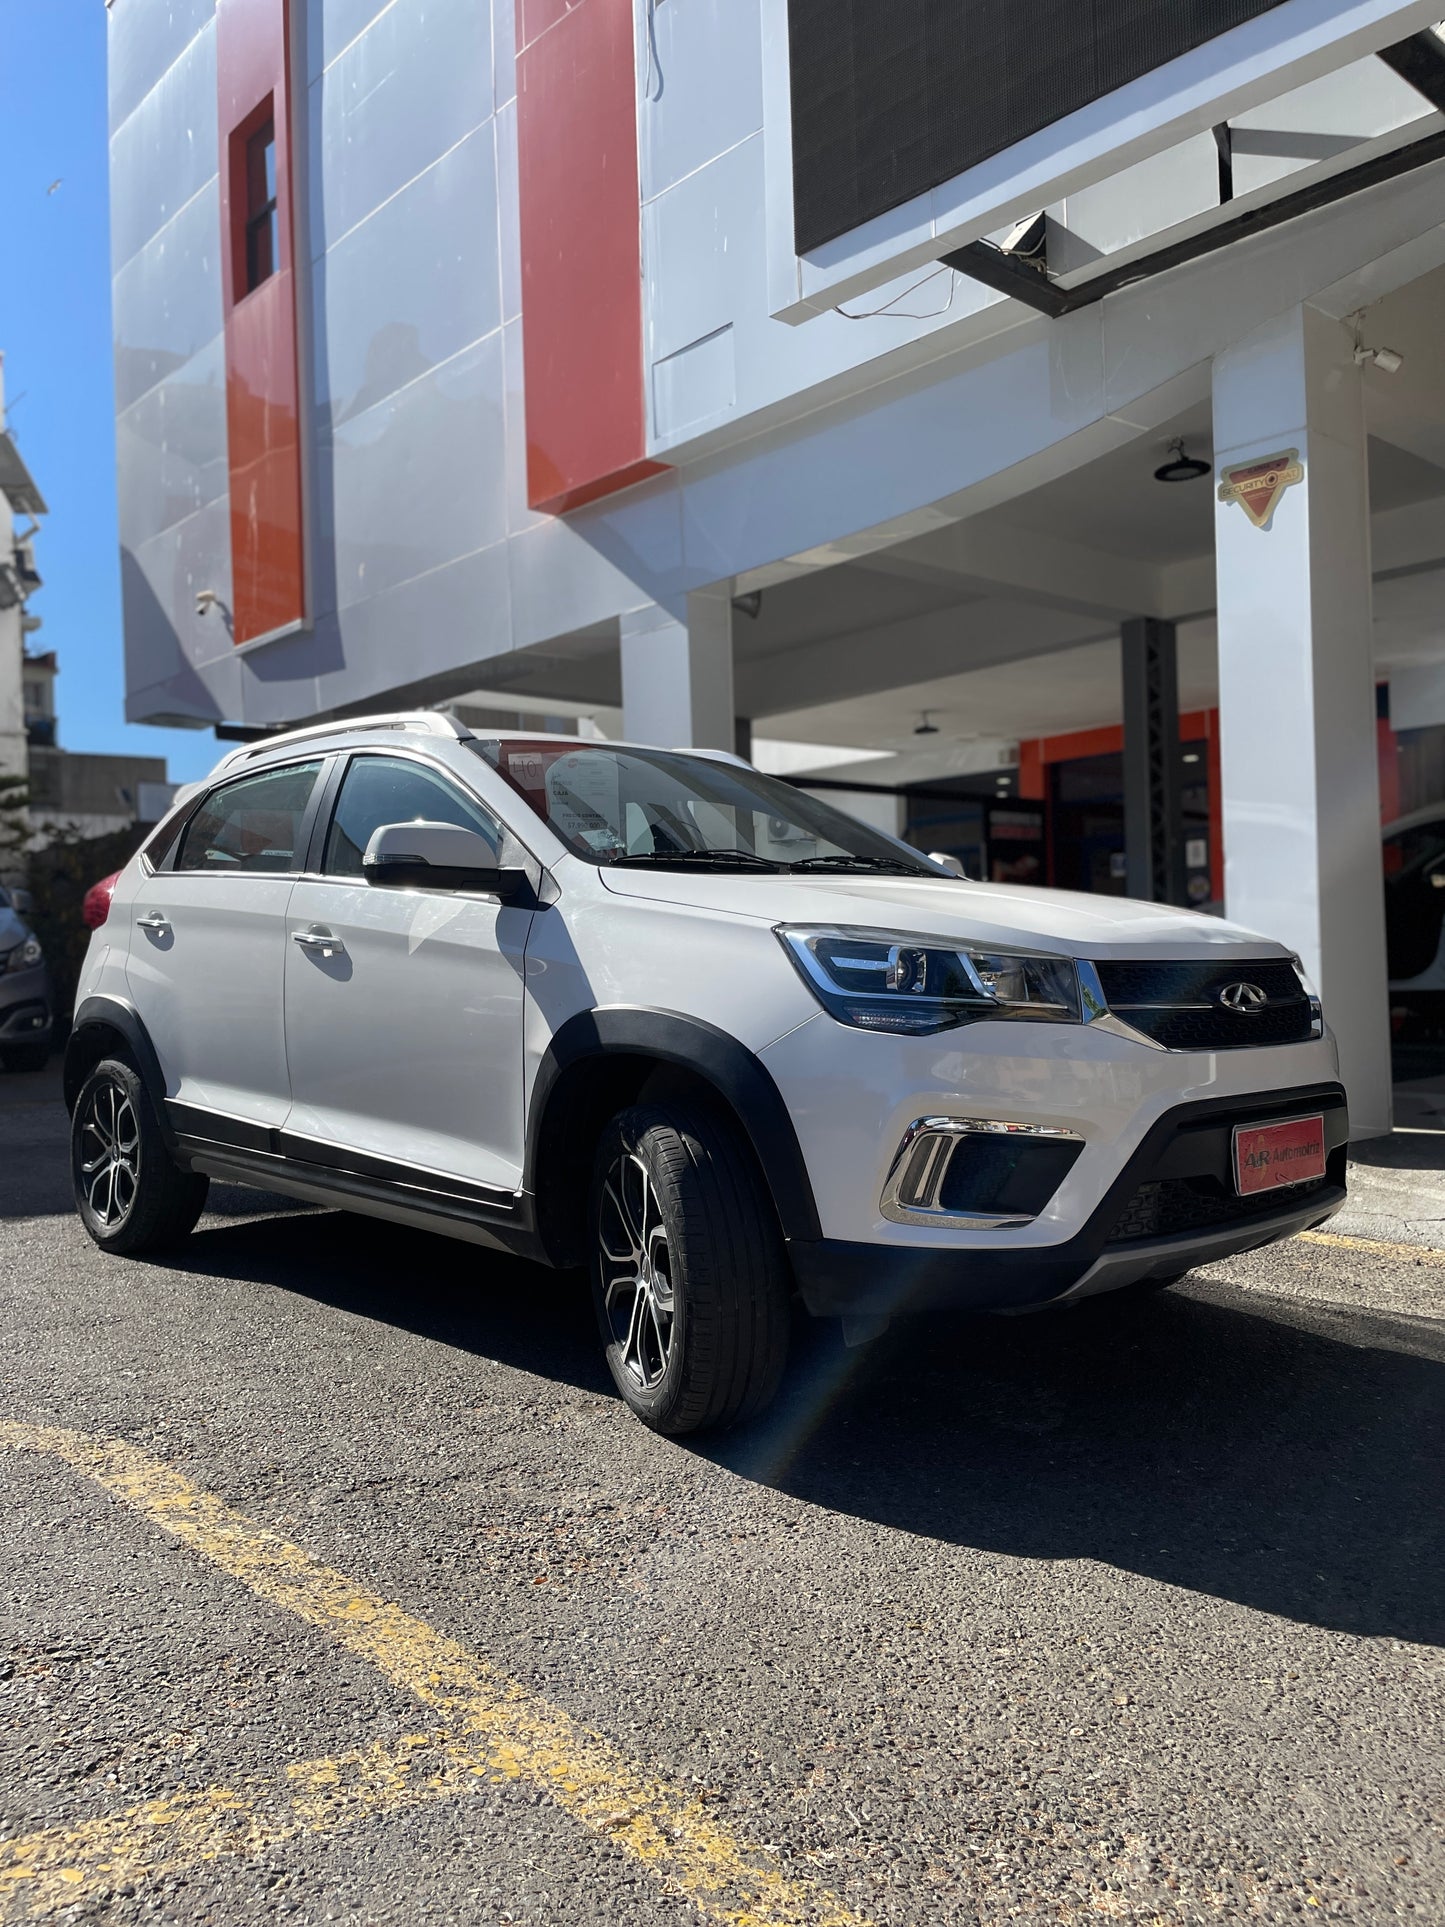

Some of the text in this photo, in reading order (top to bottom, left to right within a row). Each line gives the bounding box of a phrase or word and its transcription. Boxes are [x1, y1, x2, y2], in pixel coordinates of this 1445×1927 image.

[1222, 479, 1265, 497] SECURITY
[513, 760, 537, 779] 40
[1273, 1141, 1320, 1162] Automotriz
